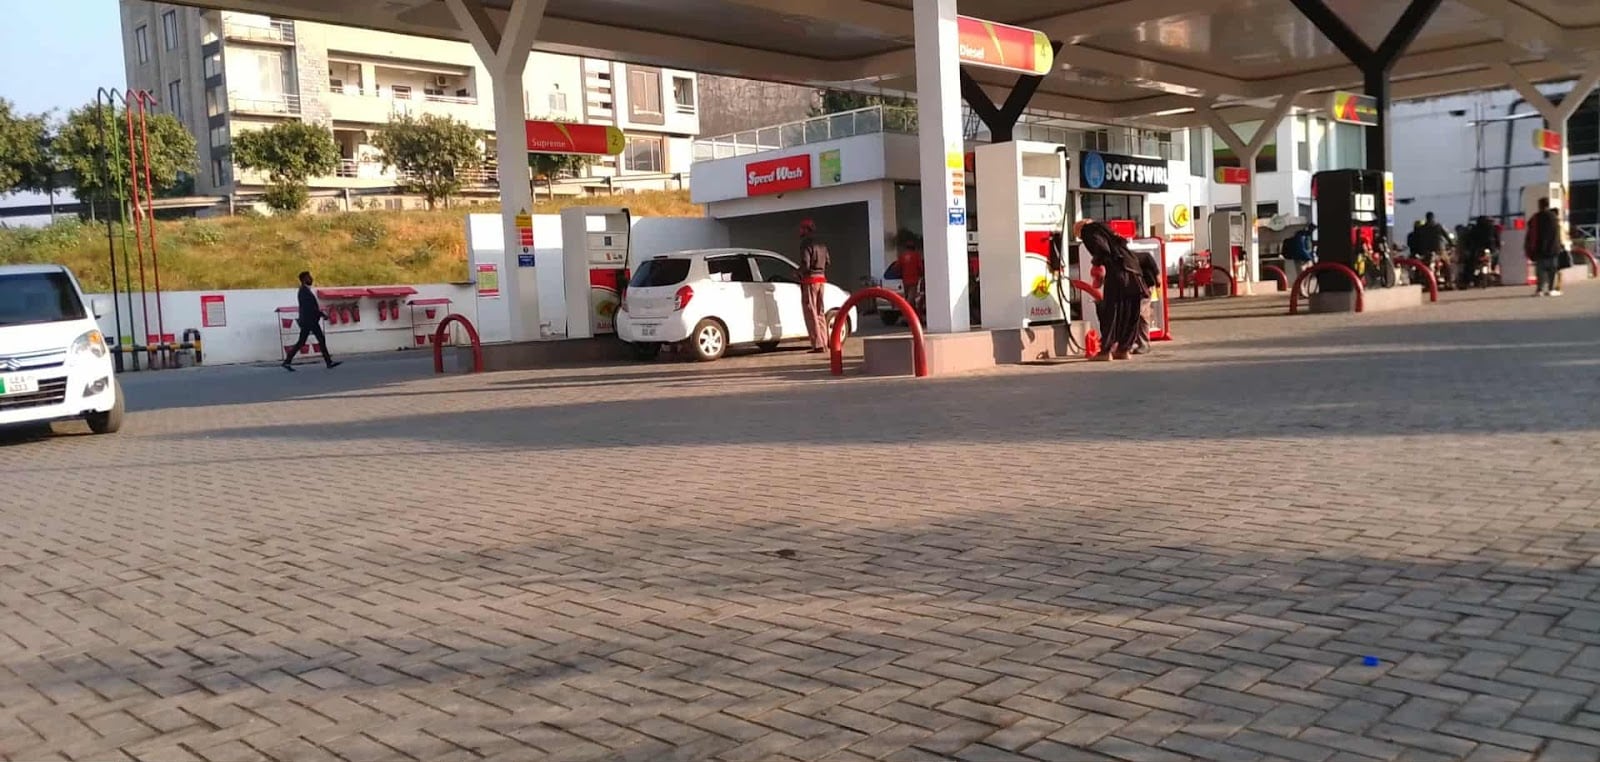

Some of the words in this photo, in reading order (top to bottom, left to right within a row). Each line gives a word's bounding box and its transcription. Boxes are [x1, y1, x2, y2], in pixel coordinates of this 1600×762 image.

[959, 44, 984, 59] Diesel
[532, 138, 566, 149] Supreme
[748, 171, 774, 186] Speed
[776, 166, 803, 180] Wash
[1030, 306, 1052, 316] Attock
